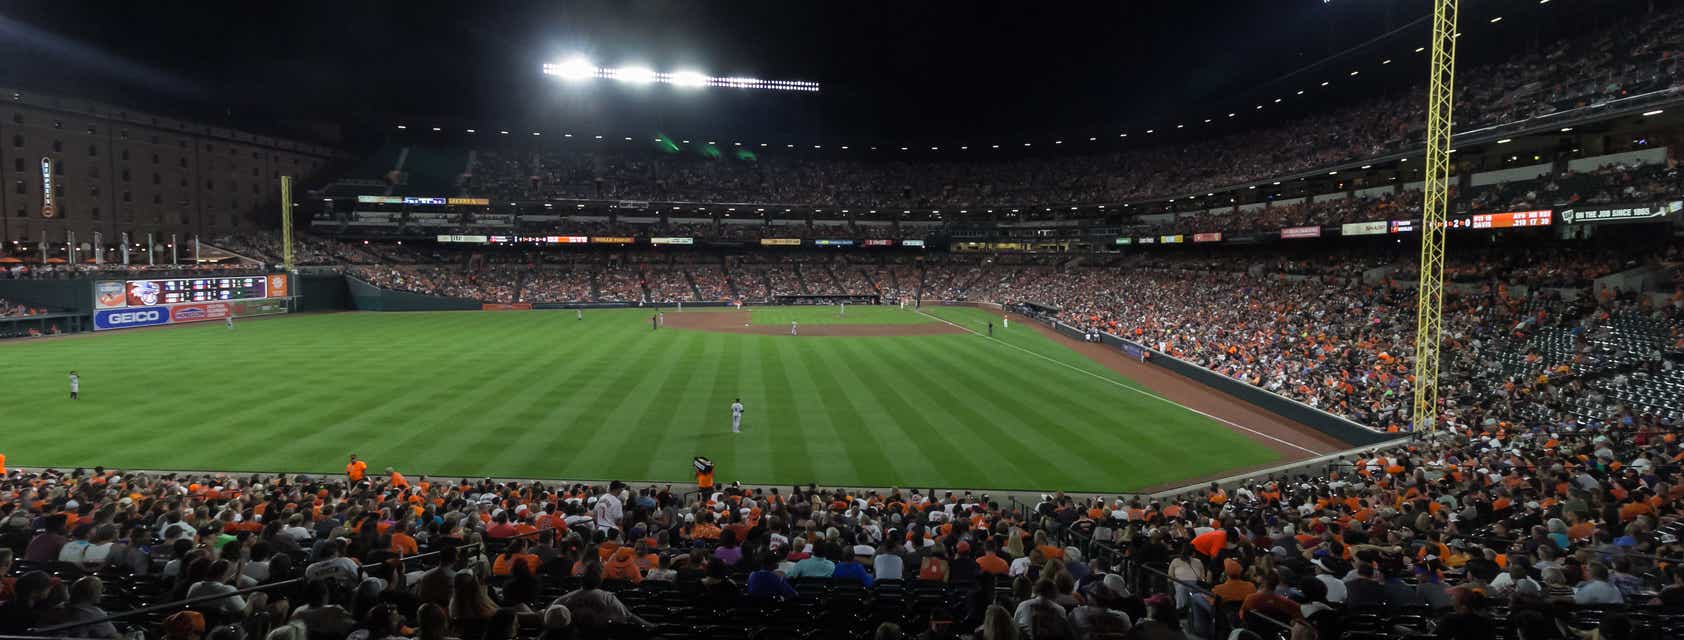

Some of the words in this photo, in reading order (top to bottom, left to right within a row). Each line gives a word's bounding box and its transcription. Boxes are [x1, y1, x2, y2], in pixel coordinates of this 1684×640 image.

[1453, 219, 1459, 228] 2
[1465, 218, 1471, 228] 0
[108, 310, 160, 325] GEICO
